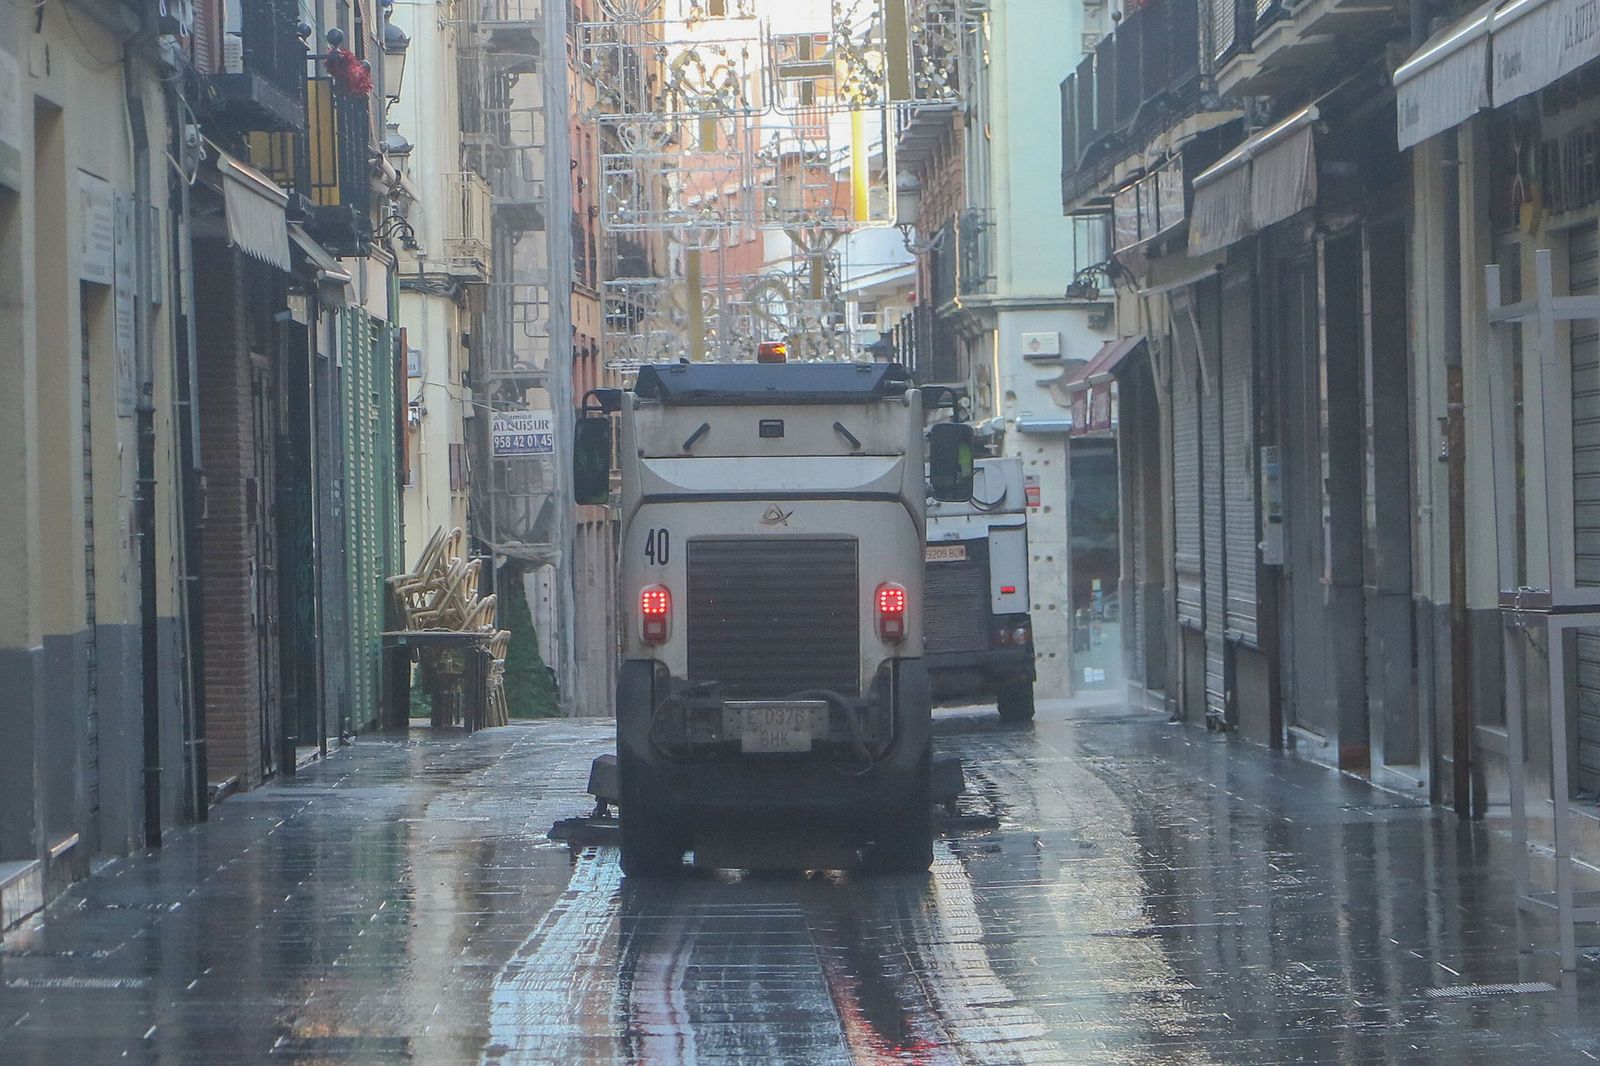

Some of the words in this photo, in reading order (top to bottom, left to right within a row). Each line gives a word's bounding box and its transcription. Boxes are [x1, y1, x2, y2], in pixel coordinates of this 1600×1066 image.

[494, 436, 511, 448] 958
[513, 435, 525, 448] 42
[527, 435, 537, 447] 01
[540, 434, 552, 446] 45
[644, 528, 669, 565] 40
[766, 708, 804, 725] 0376
